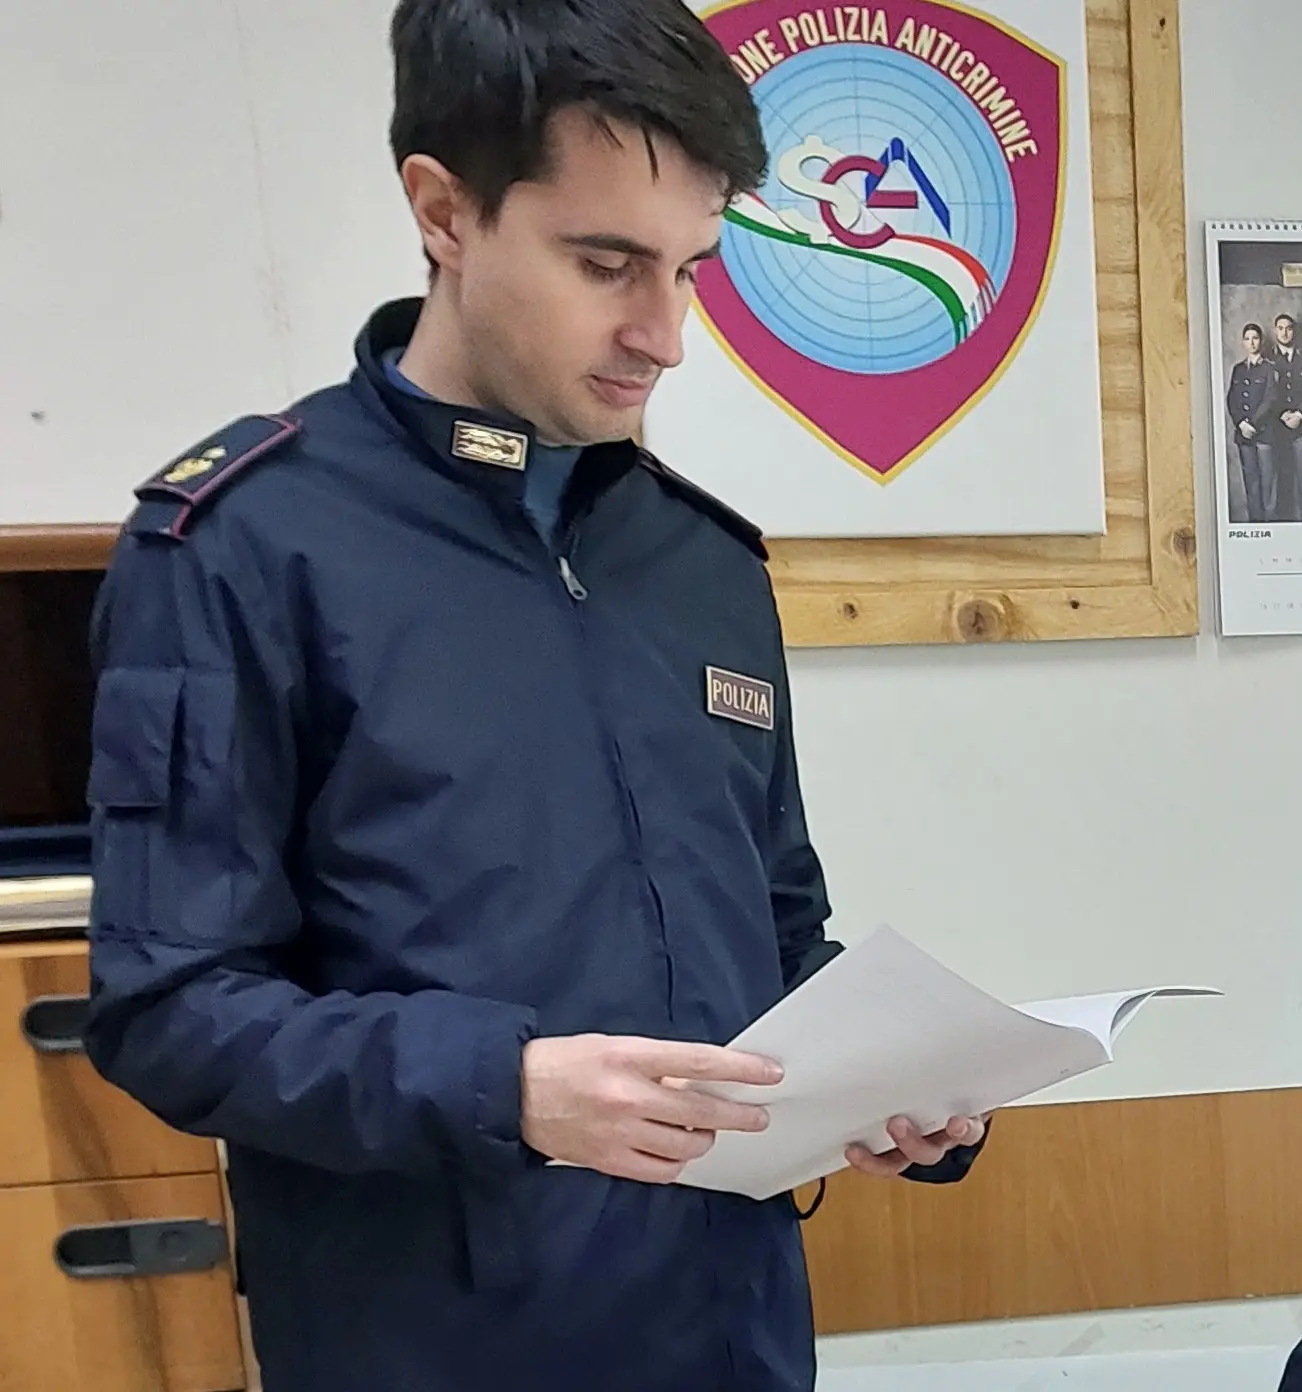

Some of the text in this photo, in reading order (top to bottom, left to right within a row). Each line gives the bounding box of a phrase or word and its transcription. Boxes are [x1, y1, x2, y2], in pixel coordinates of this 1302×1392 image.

[778, 7, 889, 52] POLIZIA
[895, 17, 1038, 163] ANTICRIMINE
[1228, 530, 1272, 538] POLIZIA
[712, 679, 769, 718] POLIZIA
